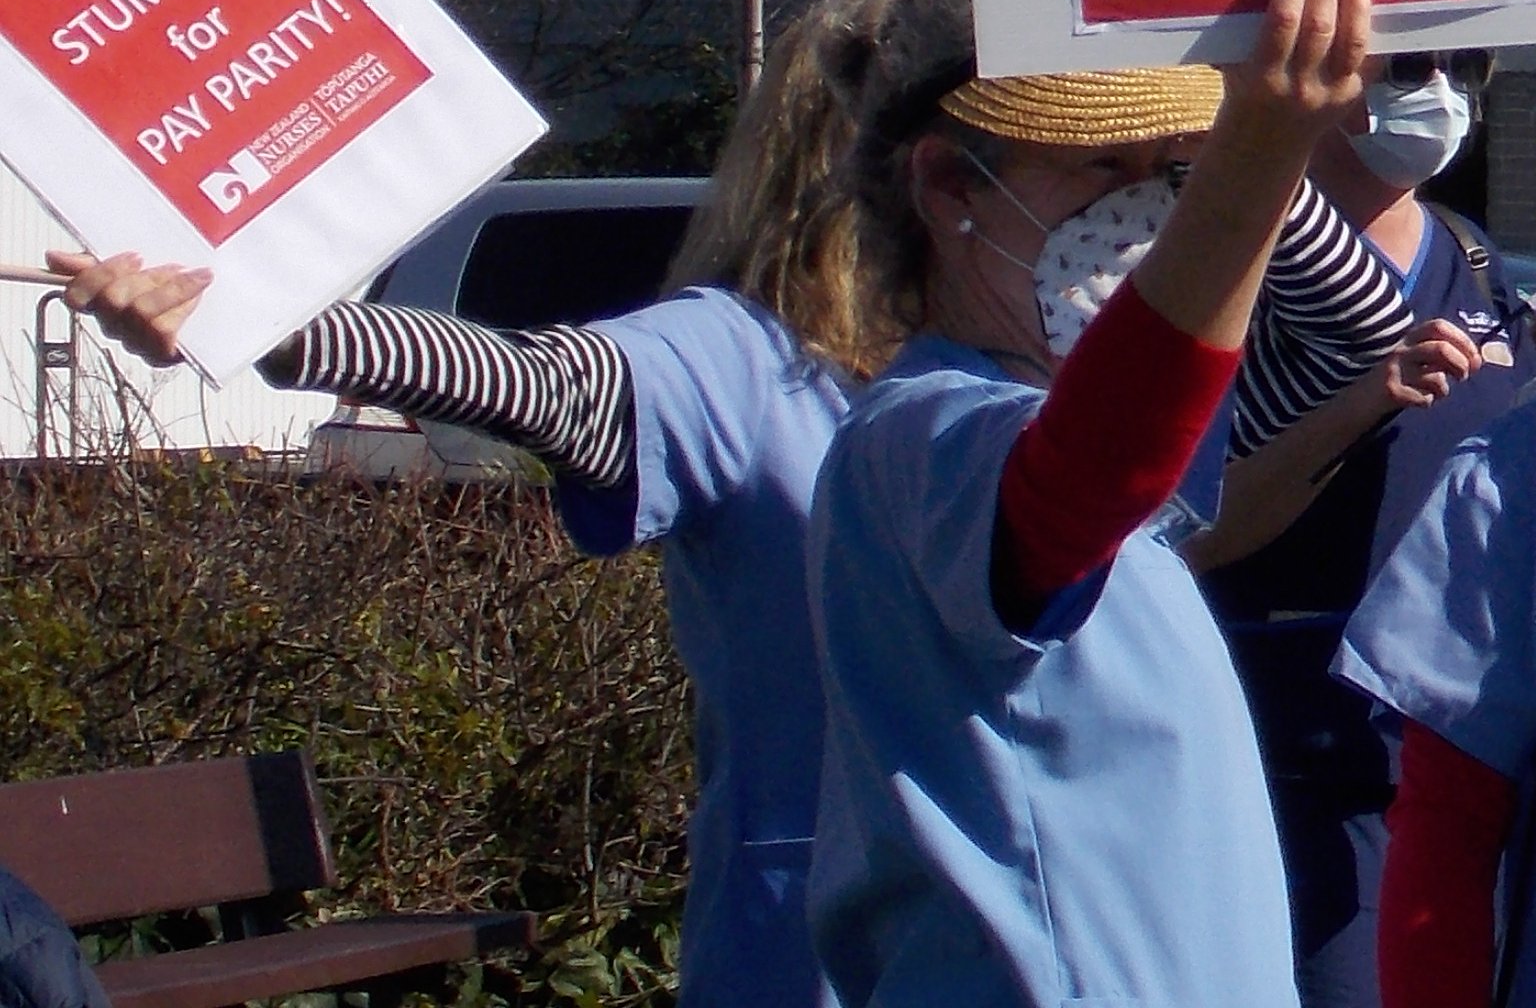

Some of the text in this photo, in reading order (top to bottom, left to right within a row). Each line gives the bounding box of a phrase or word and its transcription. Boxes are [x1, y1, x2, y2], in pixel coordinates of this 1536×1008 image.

[166, 6, 230, 61] for
[324, 62, 390, 113] TAPUHI
[137, 93, 212, 165] PAY
[258, 111, 323, 164] NURSES
